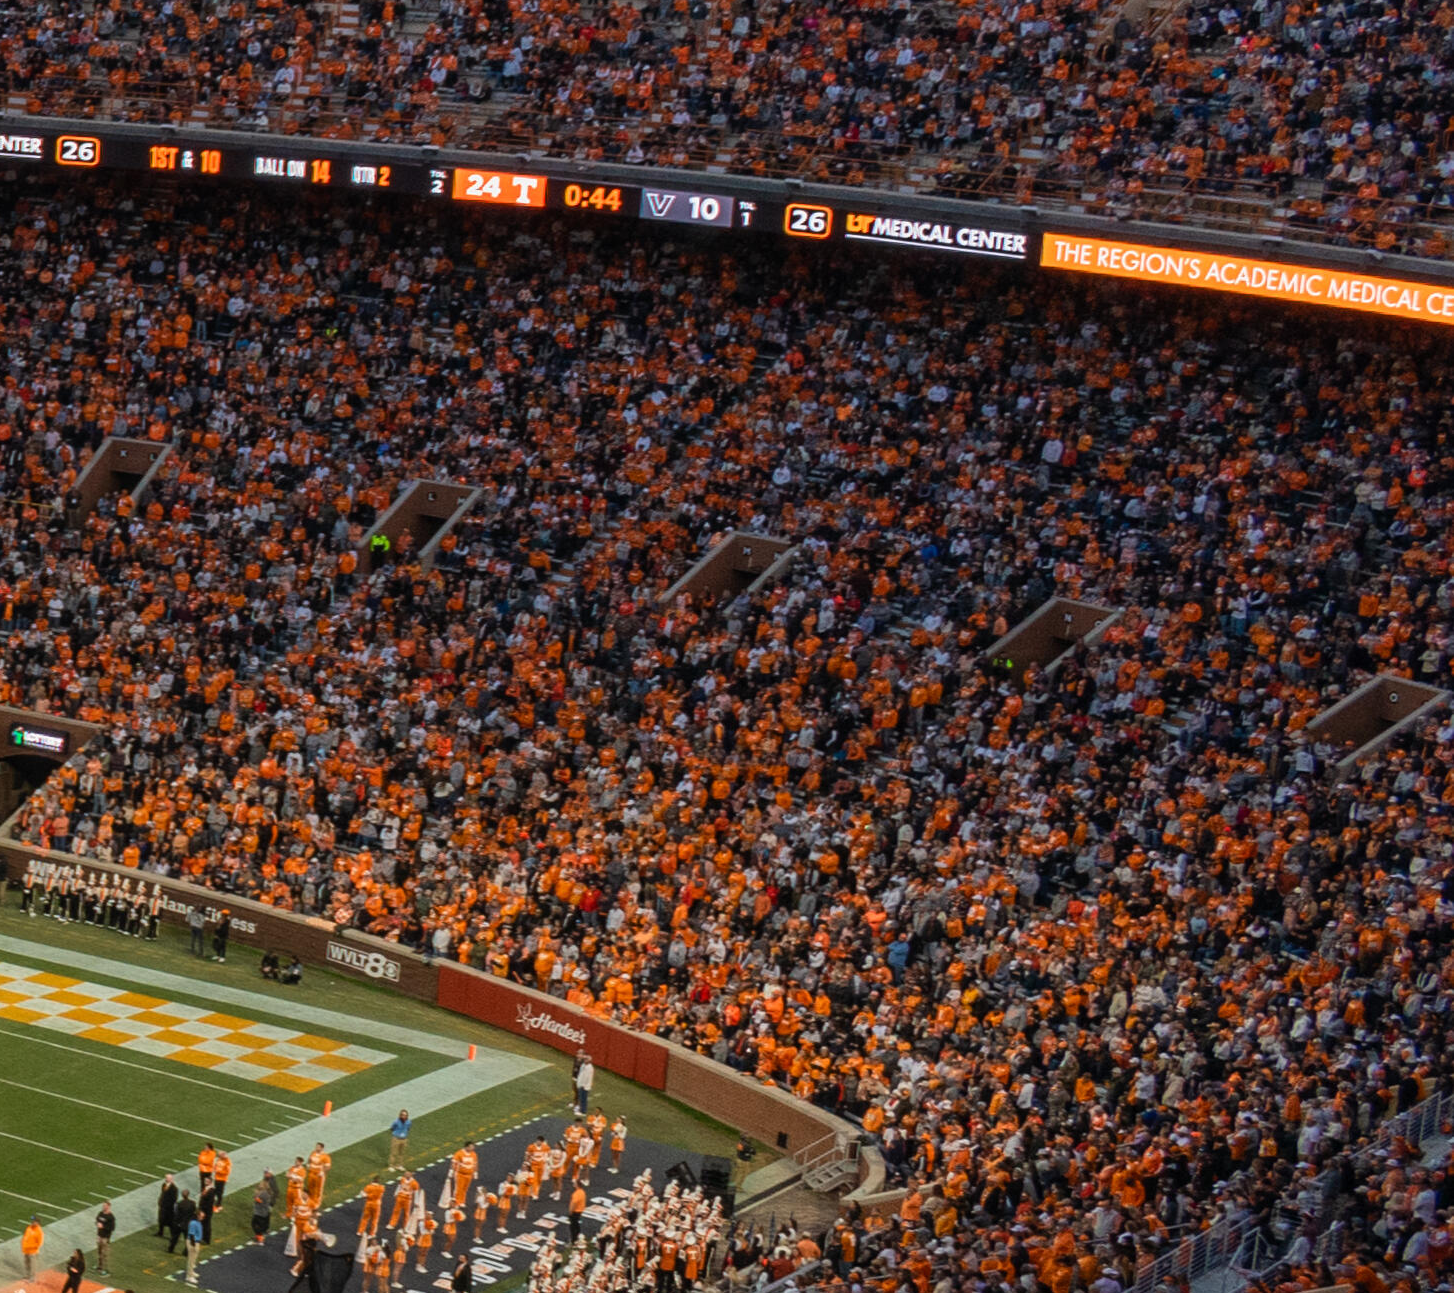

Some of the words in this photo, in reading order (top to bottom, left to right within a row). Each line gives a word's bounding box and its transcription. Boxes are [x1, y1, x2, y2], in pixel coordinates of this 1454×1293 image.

[61, 143, 95, 162] 26
[149, 147, 178, 170] 1ST
[181, 151, 194, 170] &
[200, 150, 221, 175] 10
[254, 157, 285, 176] BALL
[287, 160, 307, 179] ON
[311, 160, 331, 184] 14
[378, 167, 391, 186] 2
[432, 180, 444, 194] 2
[466, 174, 501, 198] 24
[564, 186, 623, 211] 0:44
[688, 197, 720, 222] 10
[741, 211, 752, 226] 1
[791, 210, 826, 233] 26
[872, 219, 954, 245] MEDICAL
[956, 228, 1026, 253] CENTER
[1055, 242, 1092, 267] THE
[1097, 248, 1200, 280] REGION'S
[1205, 263, 1323, 298] ACADEMIC
[1327, 280, 1421, 312] MEDICAL
